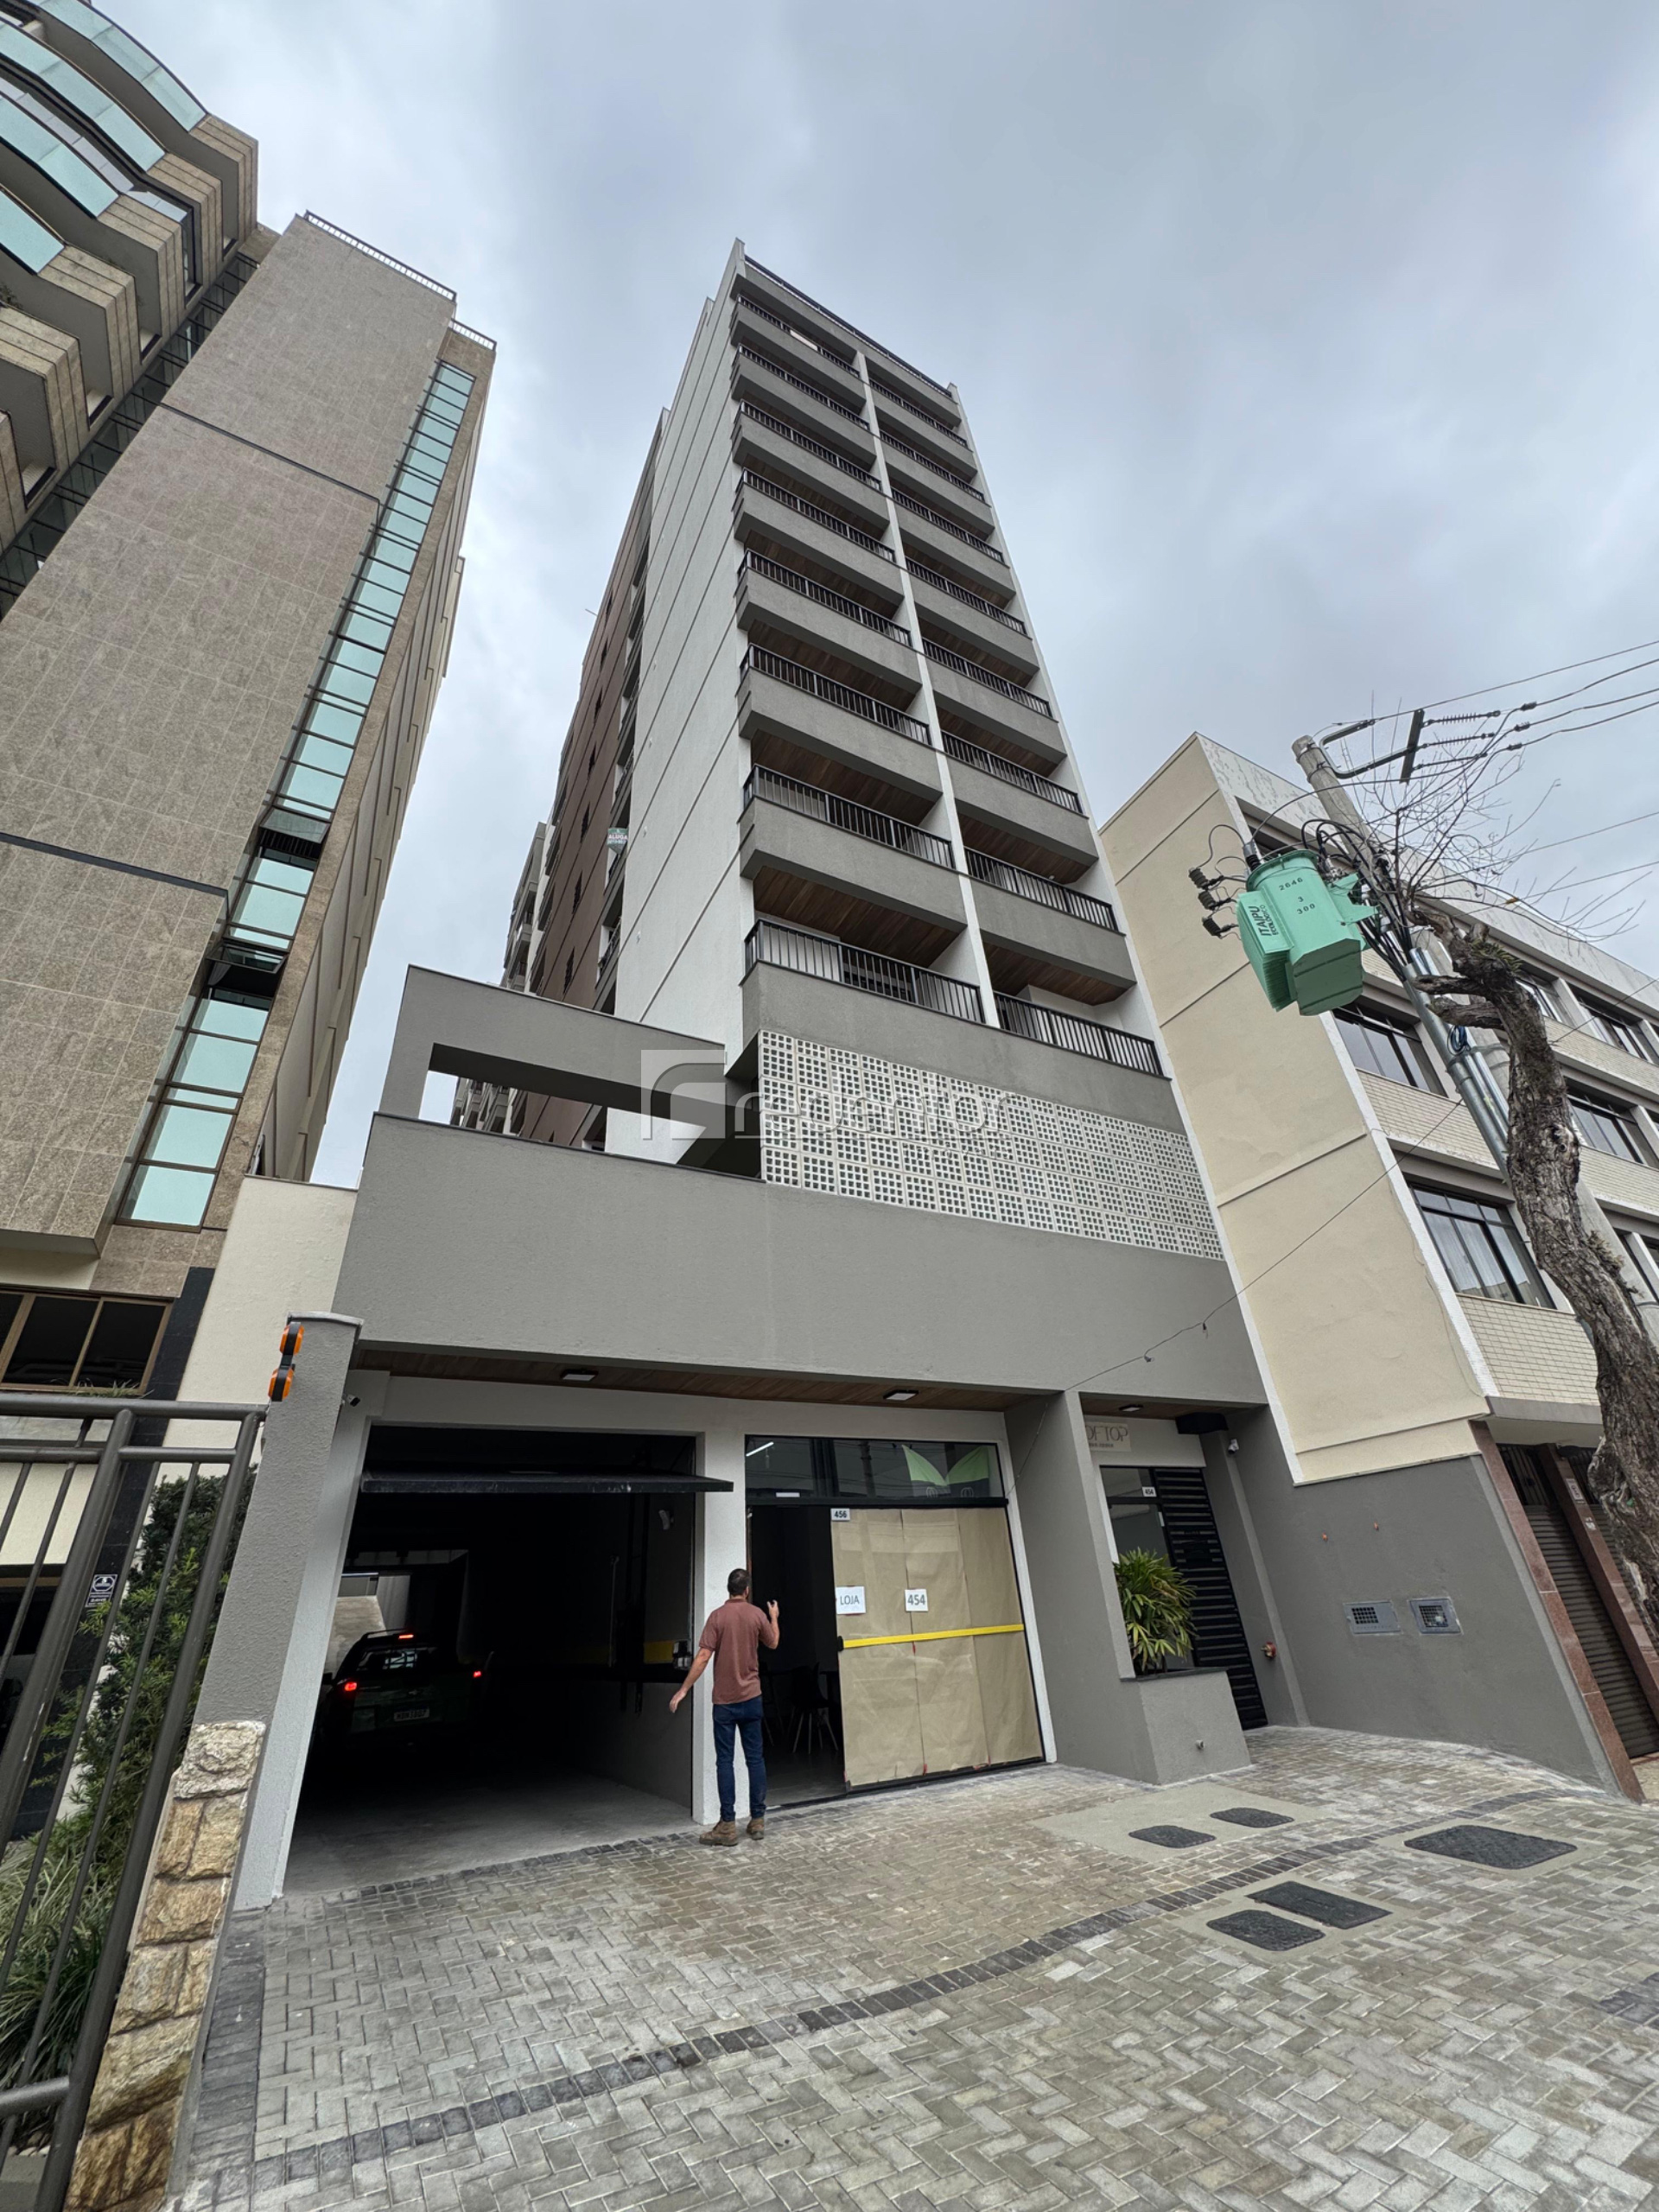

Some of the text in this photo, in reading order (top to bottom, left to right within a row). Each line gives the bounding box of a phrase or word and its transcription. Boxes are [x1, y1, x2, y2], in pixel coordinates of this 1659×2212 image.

[1296, 903, 1315, 915] 300
[1249, 906, 1272, 936] ITAIPU
[1085, 1425, 1128, 1442] OFTOP
[840, 1594, 860, 1605] LOJA
[906, 1593, 926, 1605] 454
